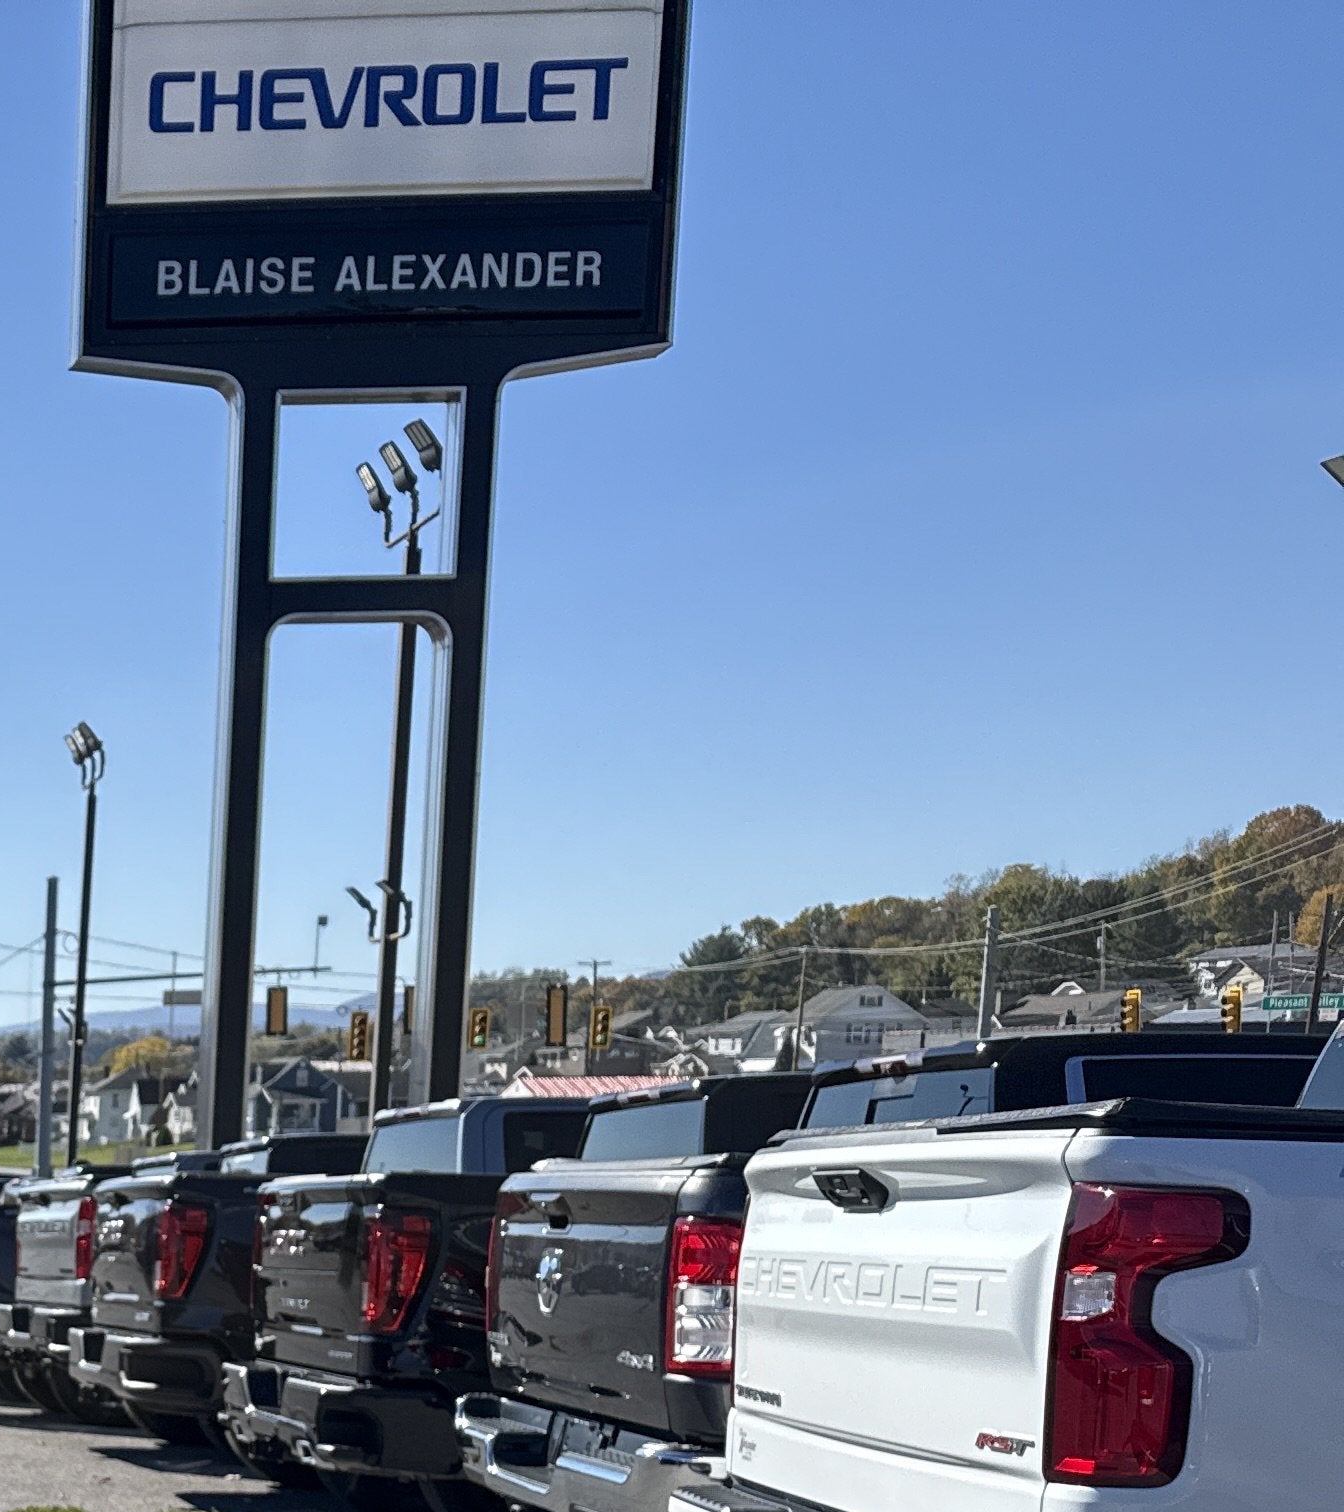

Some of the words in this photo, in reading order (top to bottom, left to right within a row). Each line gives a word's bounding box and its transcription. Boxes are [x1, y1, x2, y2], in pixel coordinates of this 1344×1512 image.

[148, 57, 629, 133] CHEVROLET
[156, 256, 315, 296] BLAISE
[333, 251, 602, 293] ALEXANDER
[1269, 995, 1308, 1008] Pleasant
[1318, 995, 1340, 1009] alley
[741, 1256, 1008, 1316] CHEVROLET
